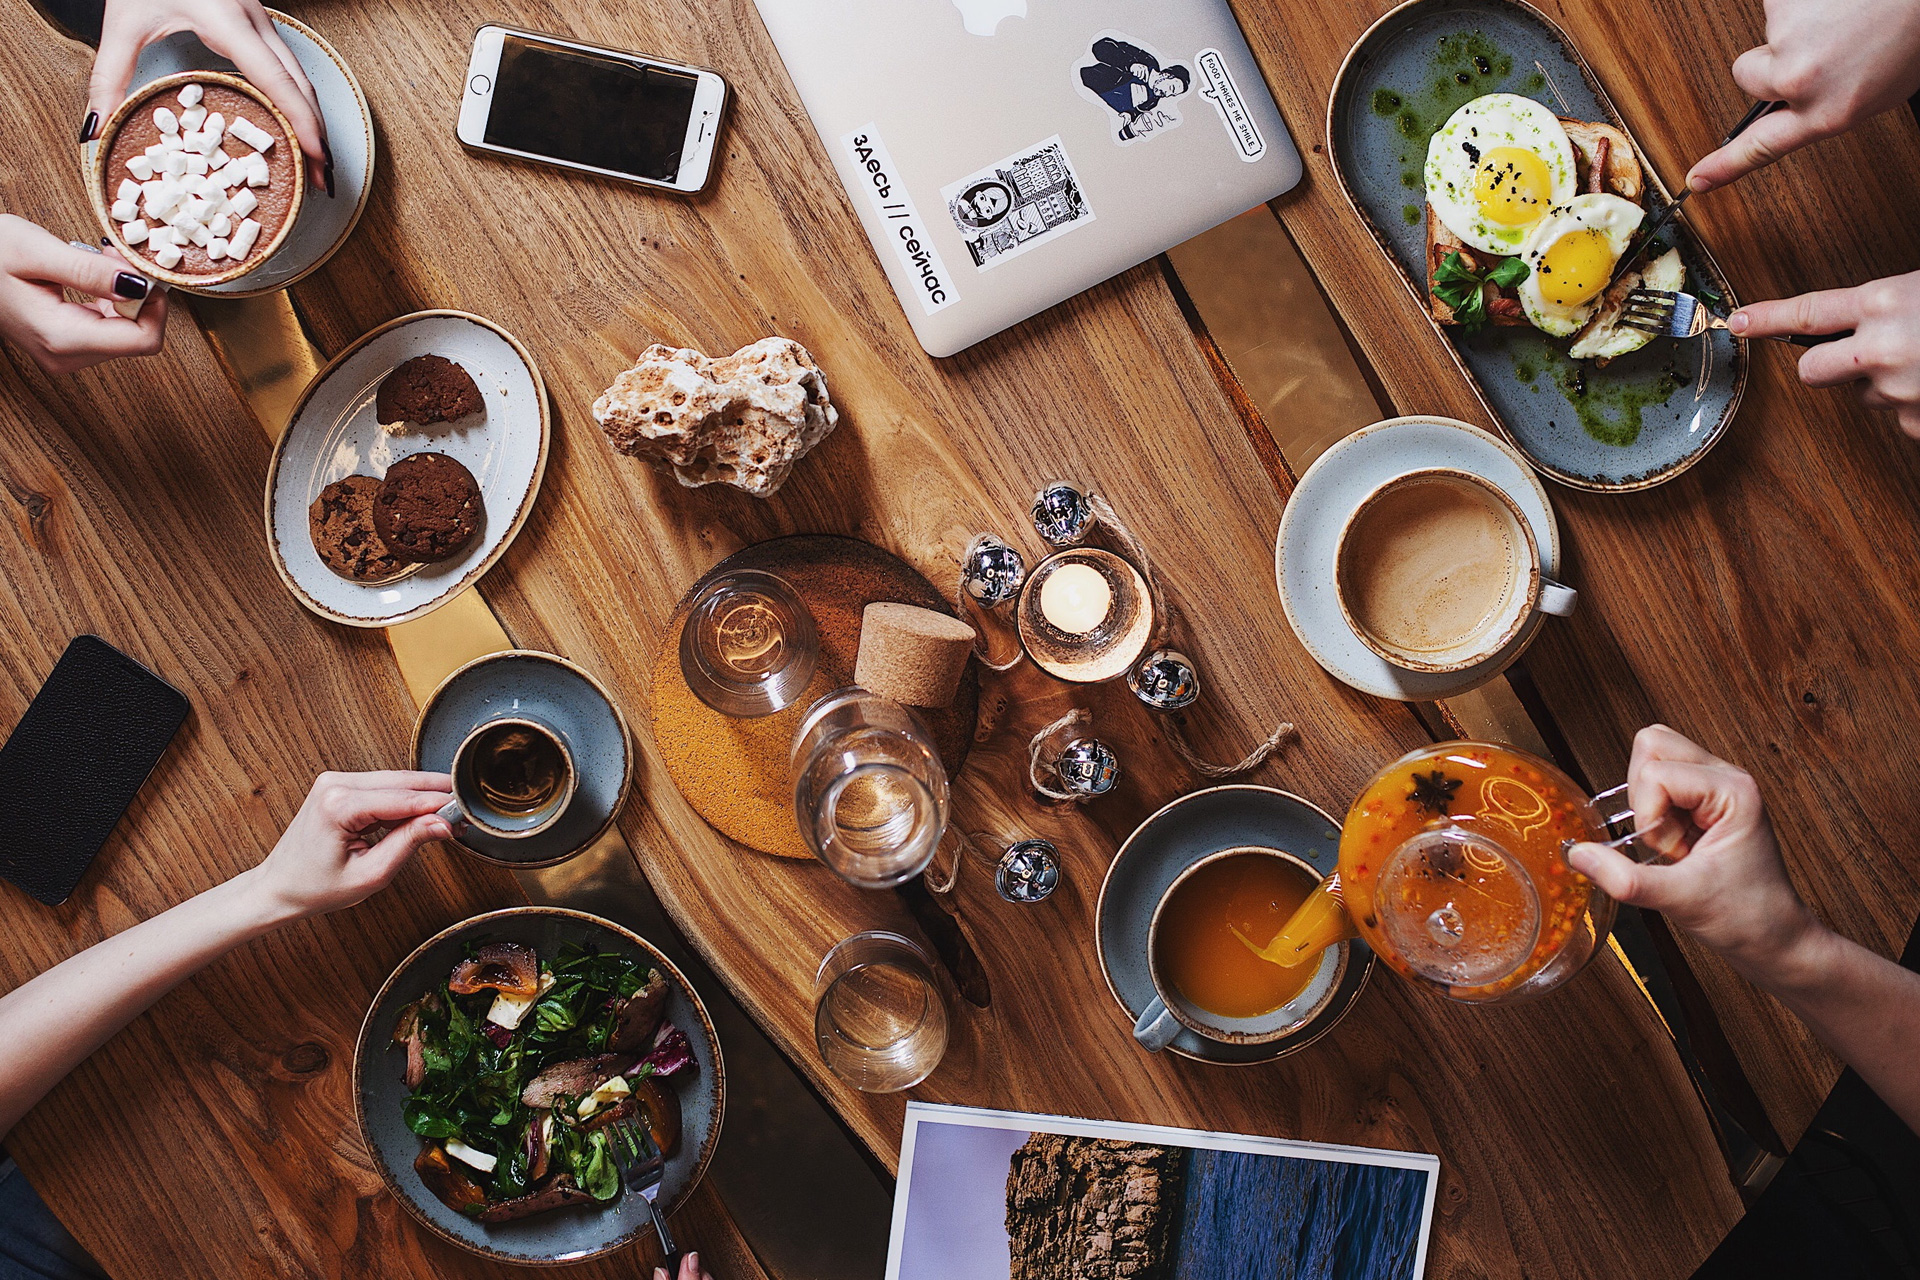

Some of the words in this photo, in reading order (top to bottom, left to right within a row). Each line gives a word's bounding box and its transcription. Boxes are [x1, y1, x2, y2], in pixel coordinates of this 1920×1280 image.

[1206, 58, 1221, 80] FOOD
[1217, 81, 1236, 108] MAKES
[1232, 109, 1243, 122] ME
[1238, 123, 1255, 149] SMILE.
[853, 134, 893, 199] здесь
[899, 225, 946, 305] сейчас
